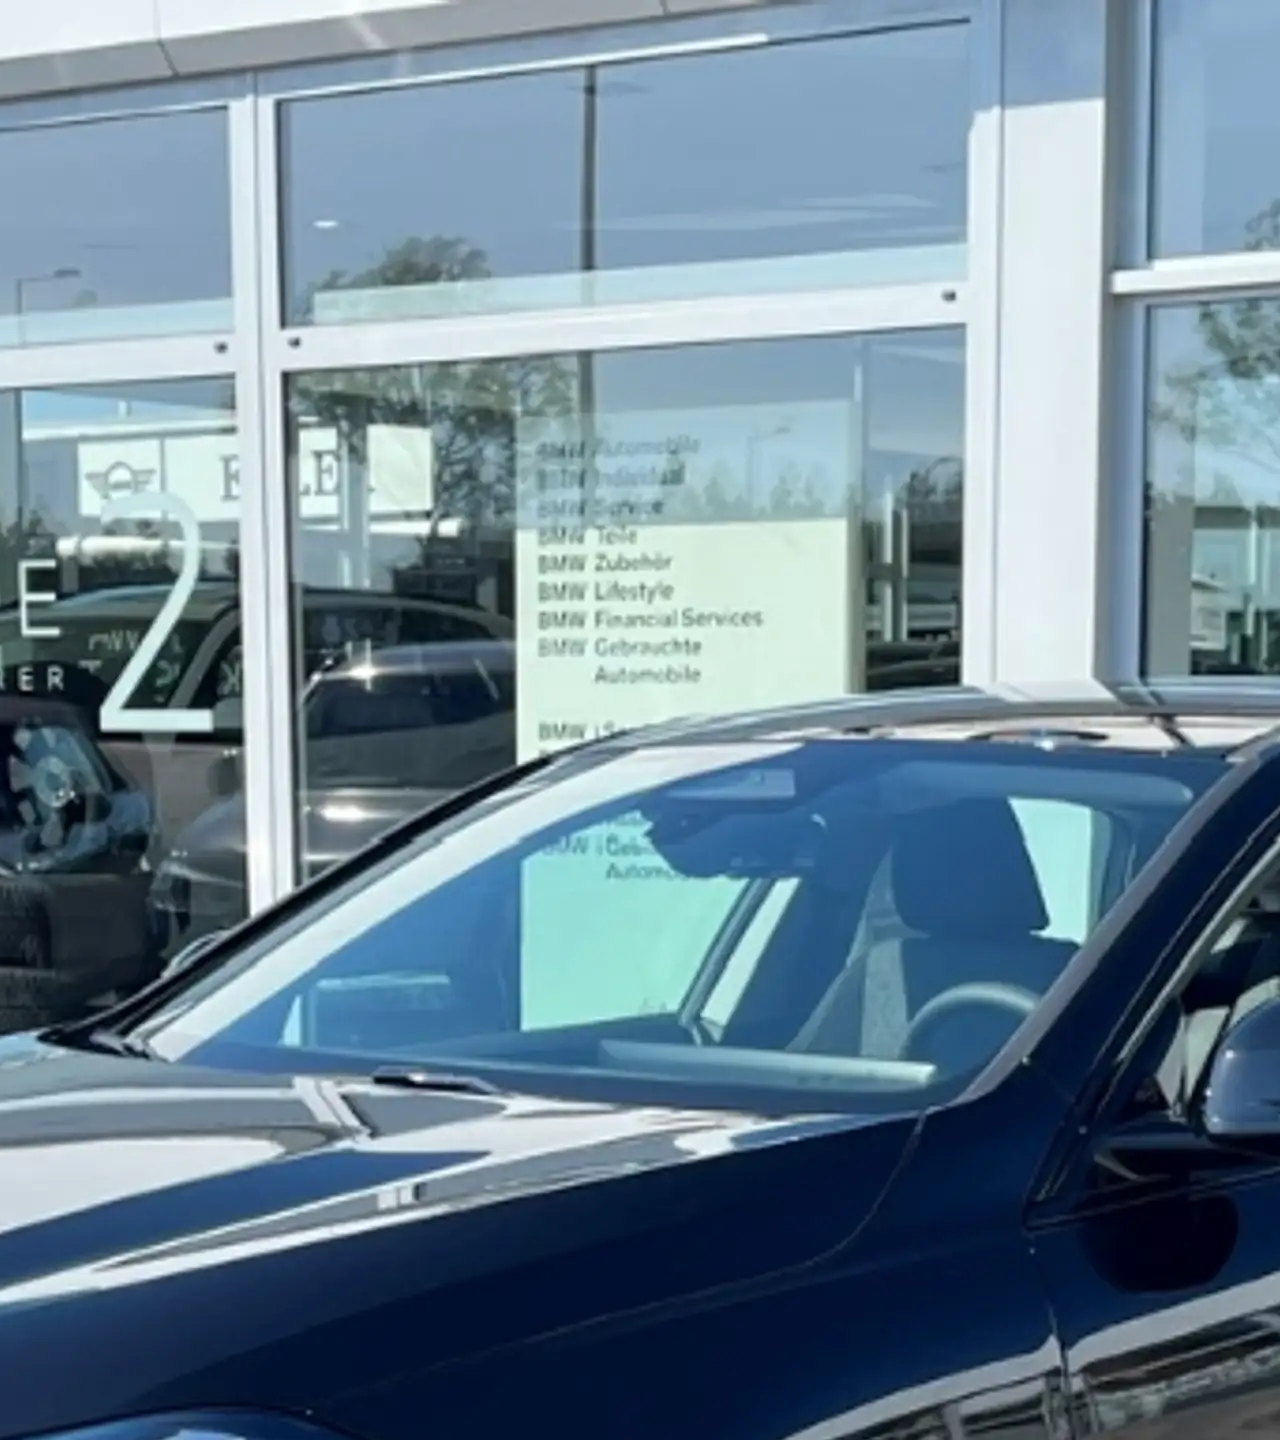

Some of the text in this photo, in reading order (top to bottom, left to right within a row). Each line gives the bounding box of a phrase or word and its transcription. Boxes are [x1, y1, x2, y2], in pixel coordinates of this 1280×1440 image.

[595, 525, 637, 545] Teile
[537, 553, 673, 574] BMW Zubehör
[537, 581, 674, 604] BMW Lifestyle
[99, 490, 215, 734] 2
[537, 608, 764, 630] BMW Financial Services
[537, 637, 702, 658] BMW Gebrauchte
[594, 665, 702, 684] Automobile
[537, 722, 586, 742] BMW
